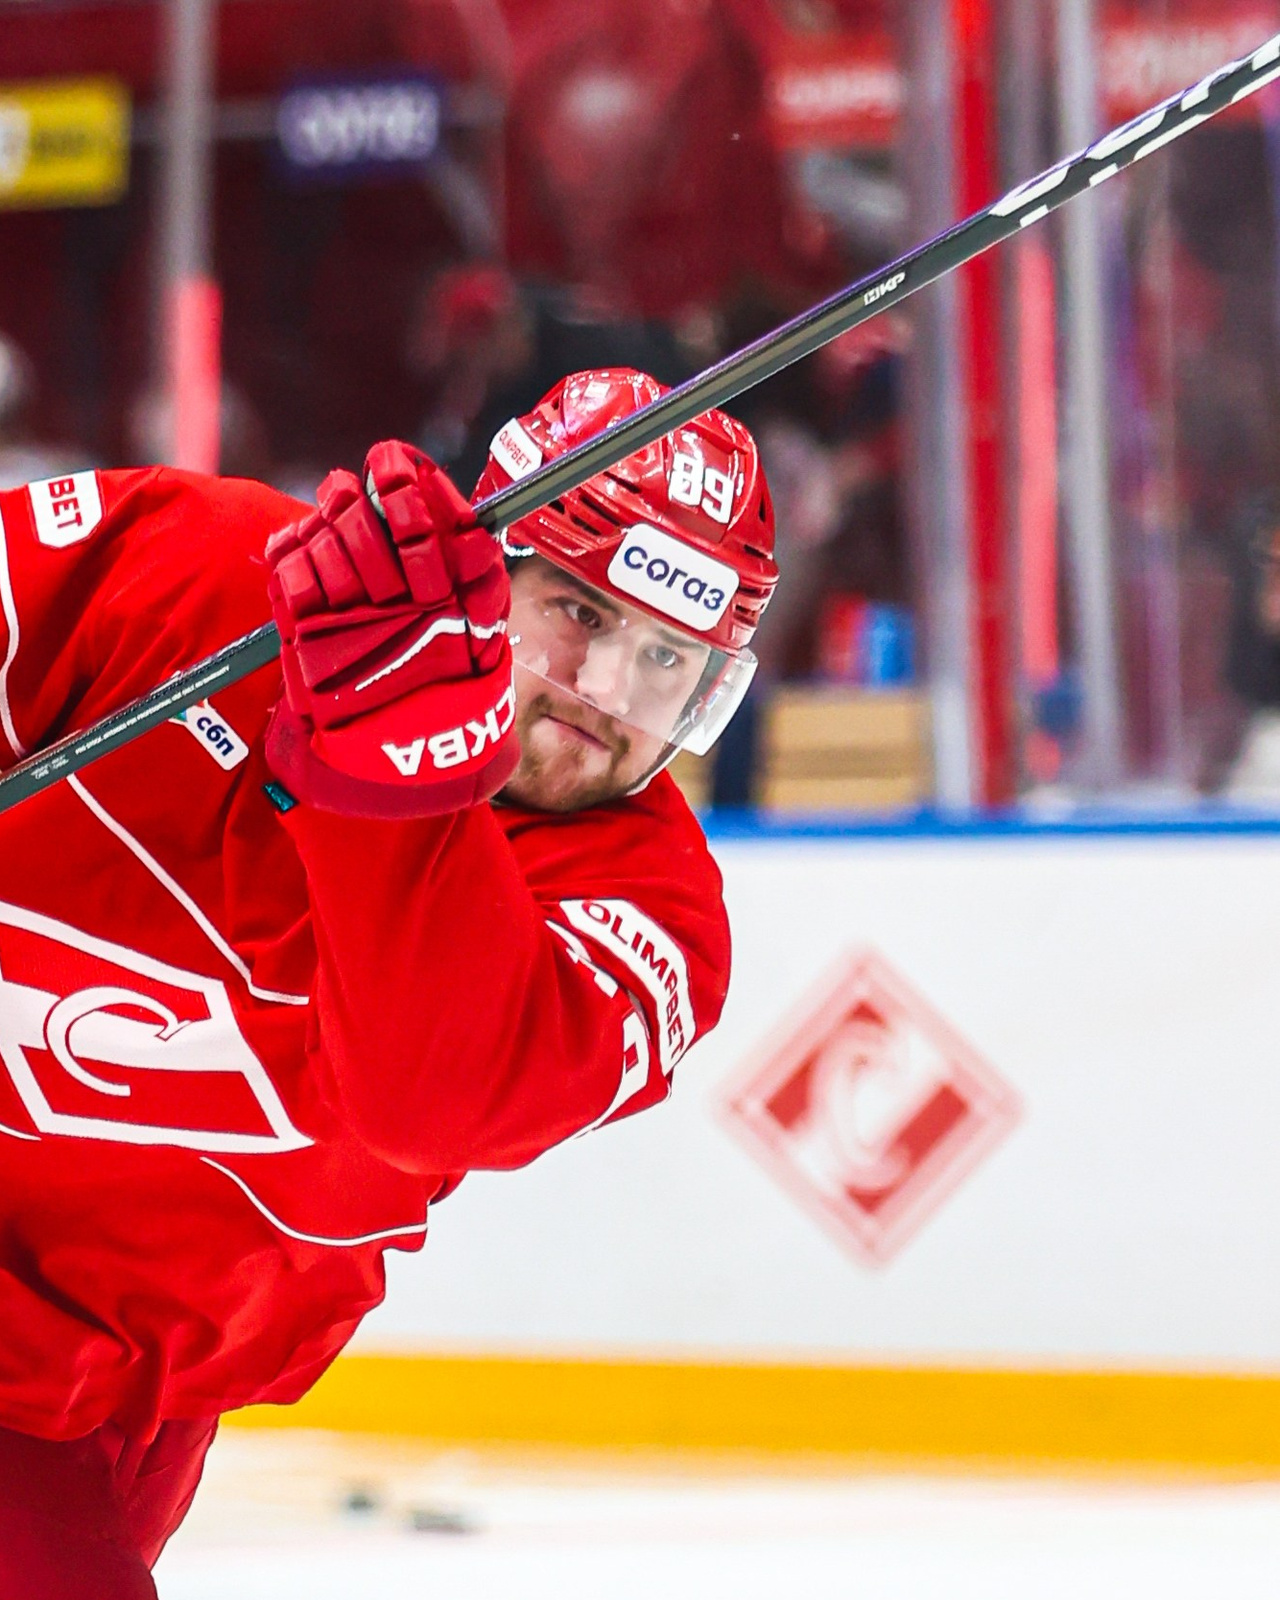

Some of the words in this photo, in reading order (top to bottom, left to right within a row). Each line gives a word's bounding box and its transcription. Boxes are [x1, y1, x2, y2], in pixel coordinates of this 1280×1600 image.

[47, 477, 83, 529] BET
[668, 452, 735, 524] 89
[623, 546, 726, 612] согаз
[196, 716, 235, 757] сбп
[381, 685, 517, 777] СКВА
